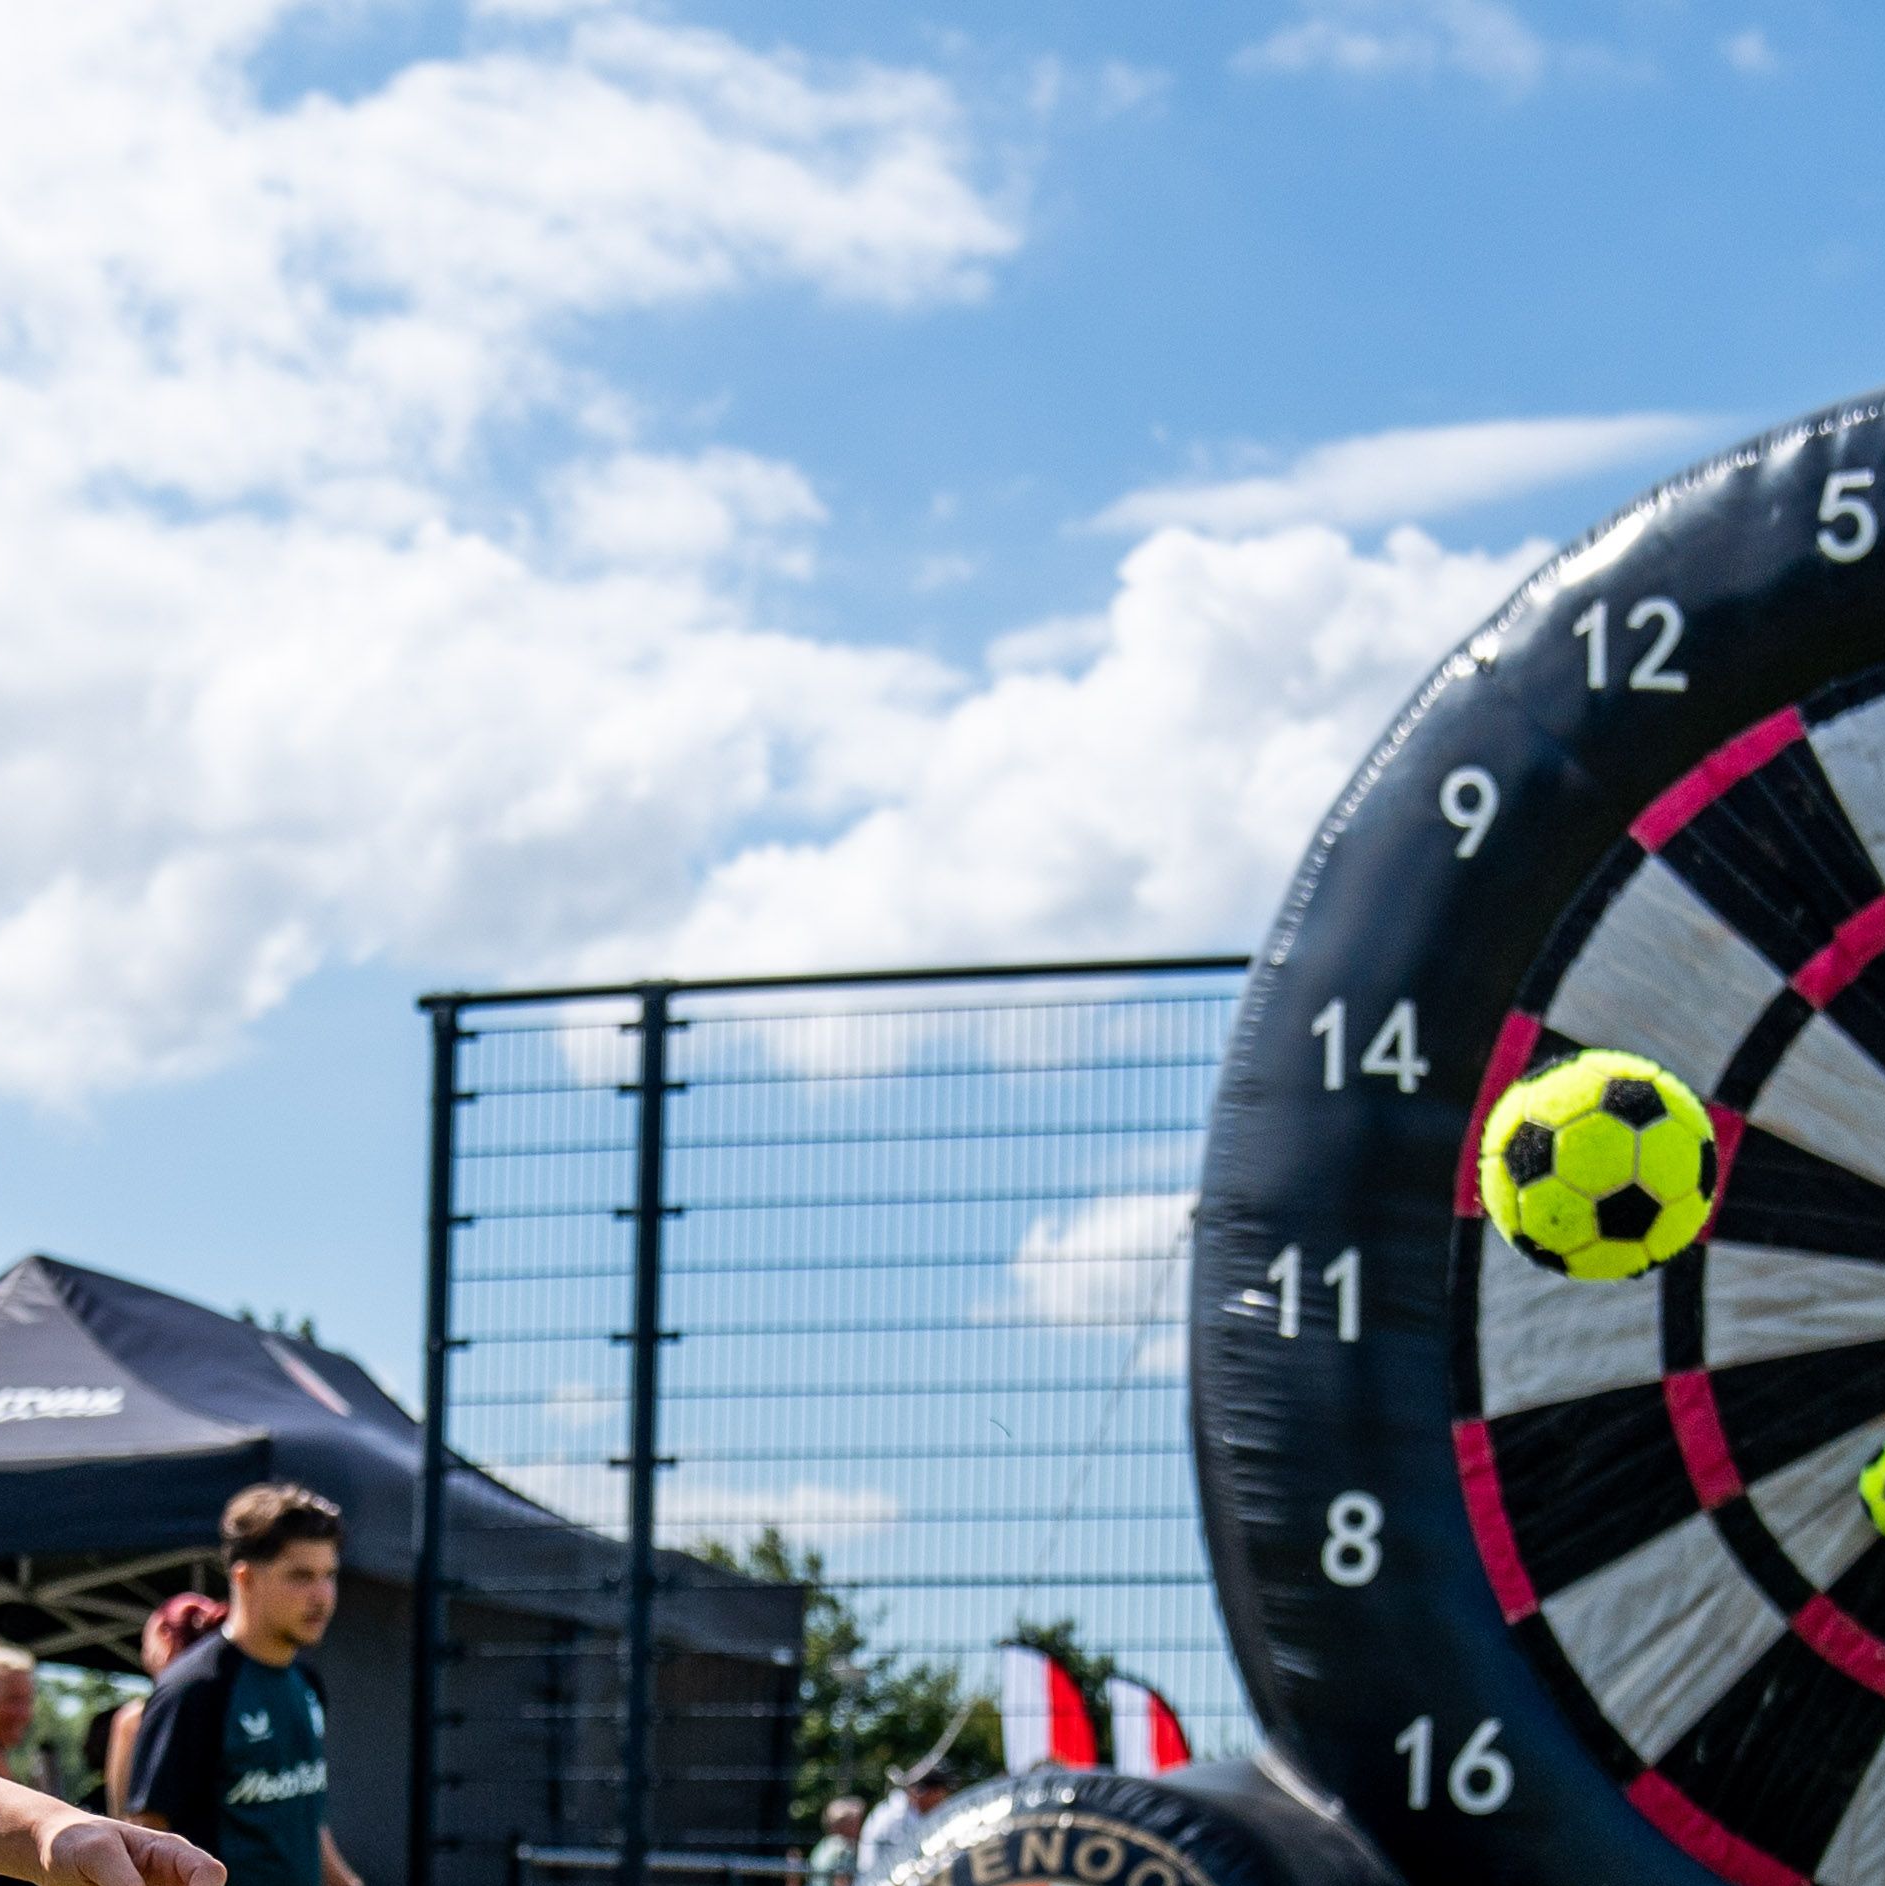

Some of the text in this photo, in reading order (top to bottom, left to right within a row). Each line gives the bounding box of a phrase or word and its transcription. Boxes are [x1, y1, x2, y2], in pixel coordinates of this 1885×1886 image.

[1816, 467, 1877, 563] 5
[1571, 597, 1688, 693] 12
[1438, 766, 1500, 860] 9
[1309, 999, 1428, 1094] 14
[1266, 1242, 1361, 1343] 11
[1322, 1493, 1382, 1586] 8
[1395, 1715, 1514, 1816] 16
